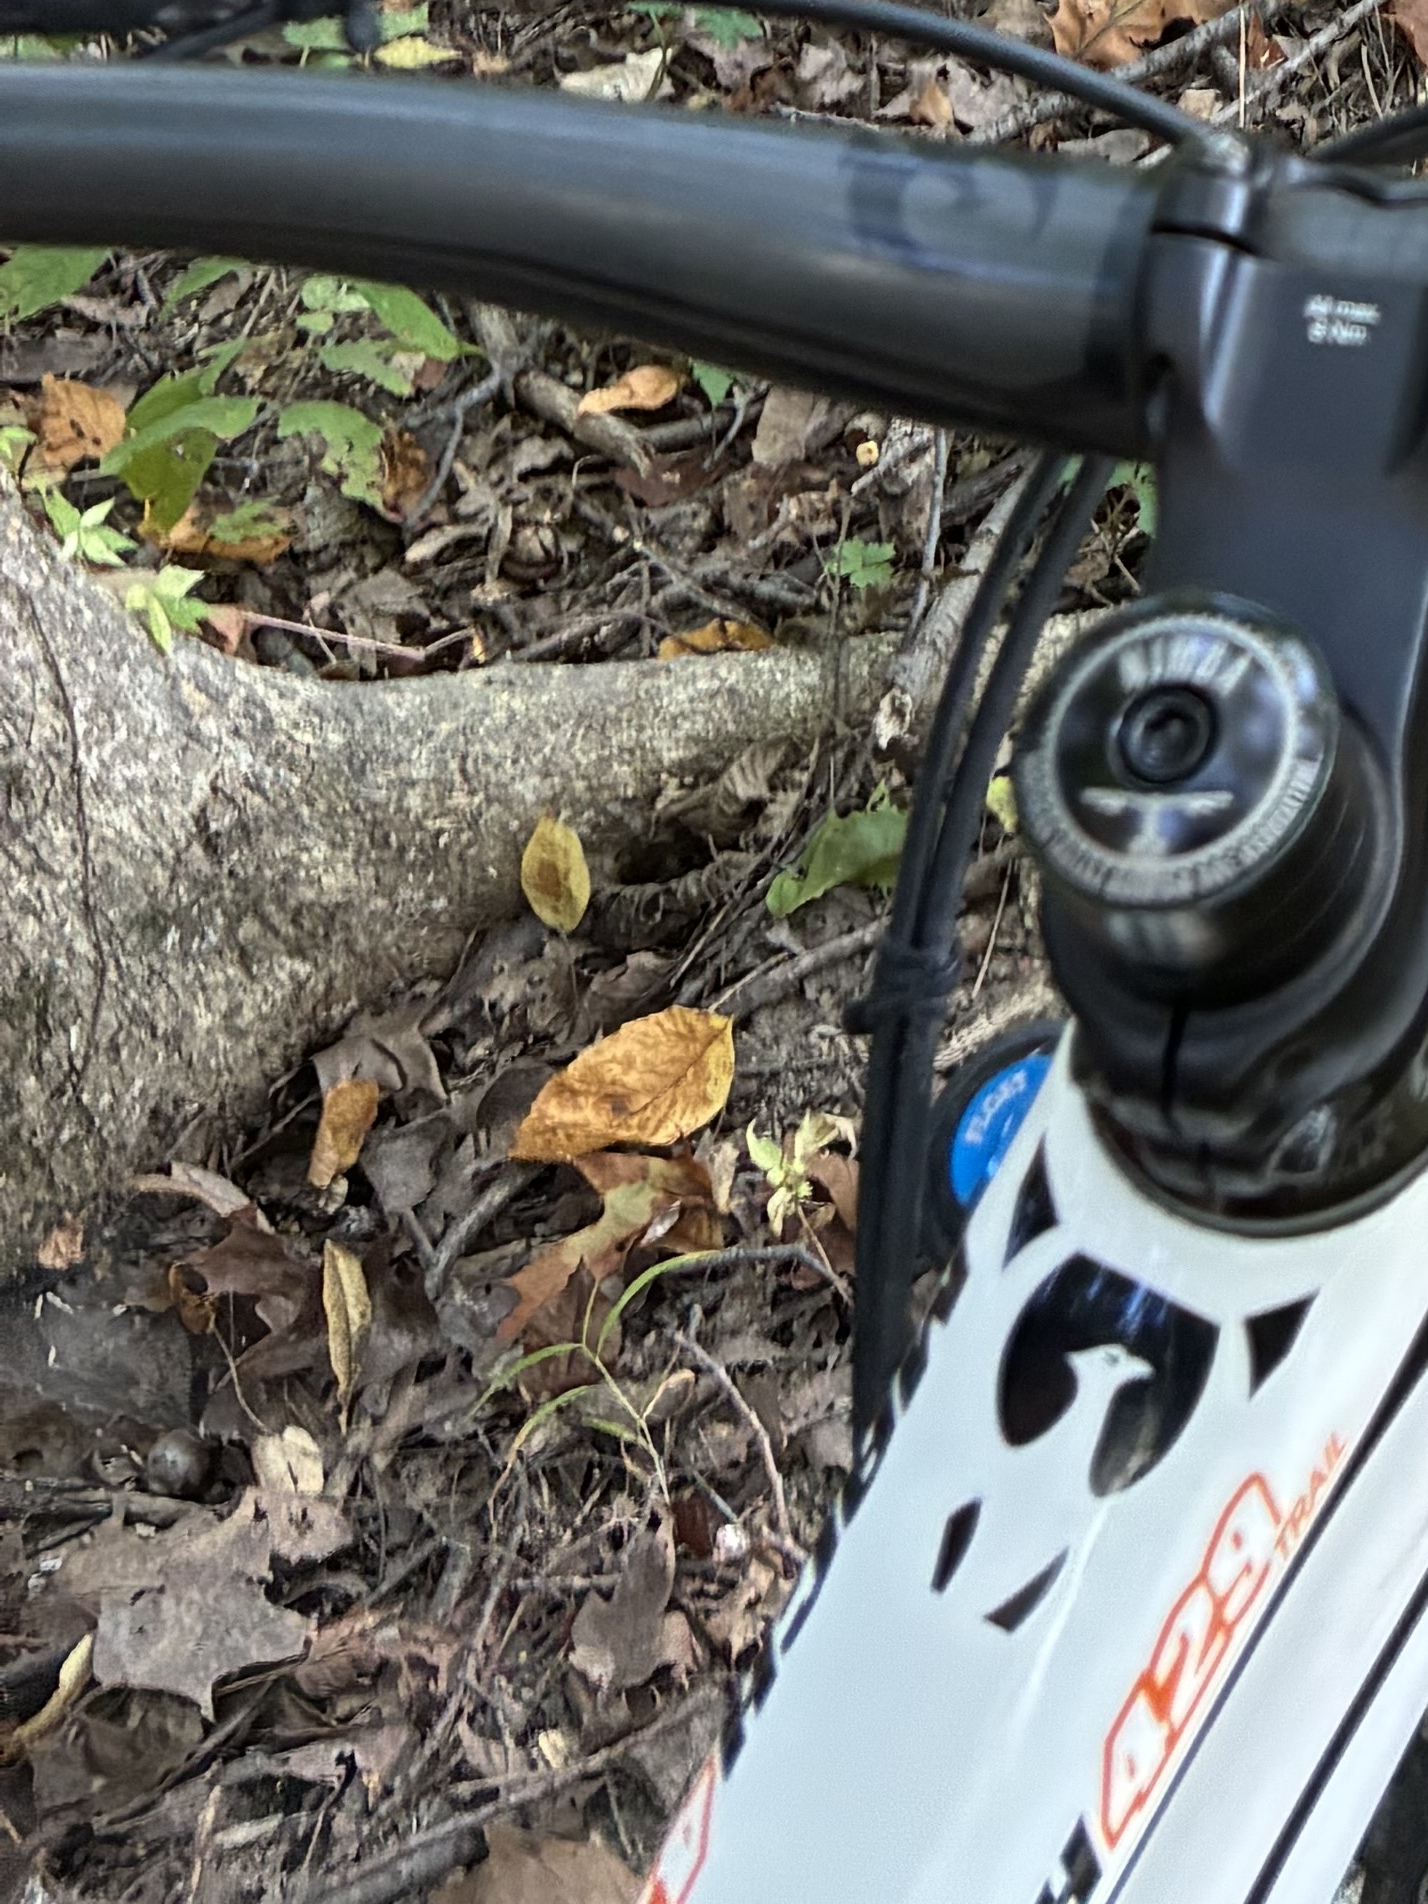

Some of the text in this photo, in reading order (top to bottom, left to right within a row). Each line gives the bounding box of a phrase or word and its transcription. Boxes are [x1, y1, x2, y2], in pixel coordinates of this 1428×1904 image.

[964, 1069, 1028, 1143] FLOAT
[1101, 1432, 1346, 1849] 429 TRAIL
